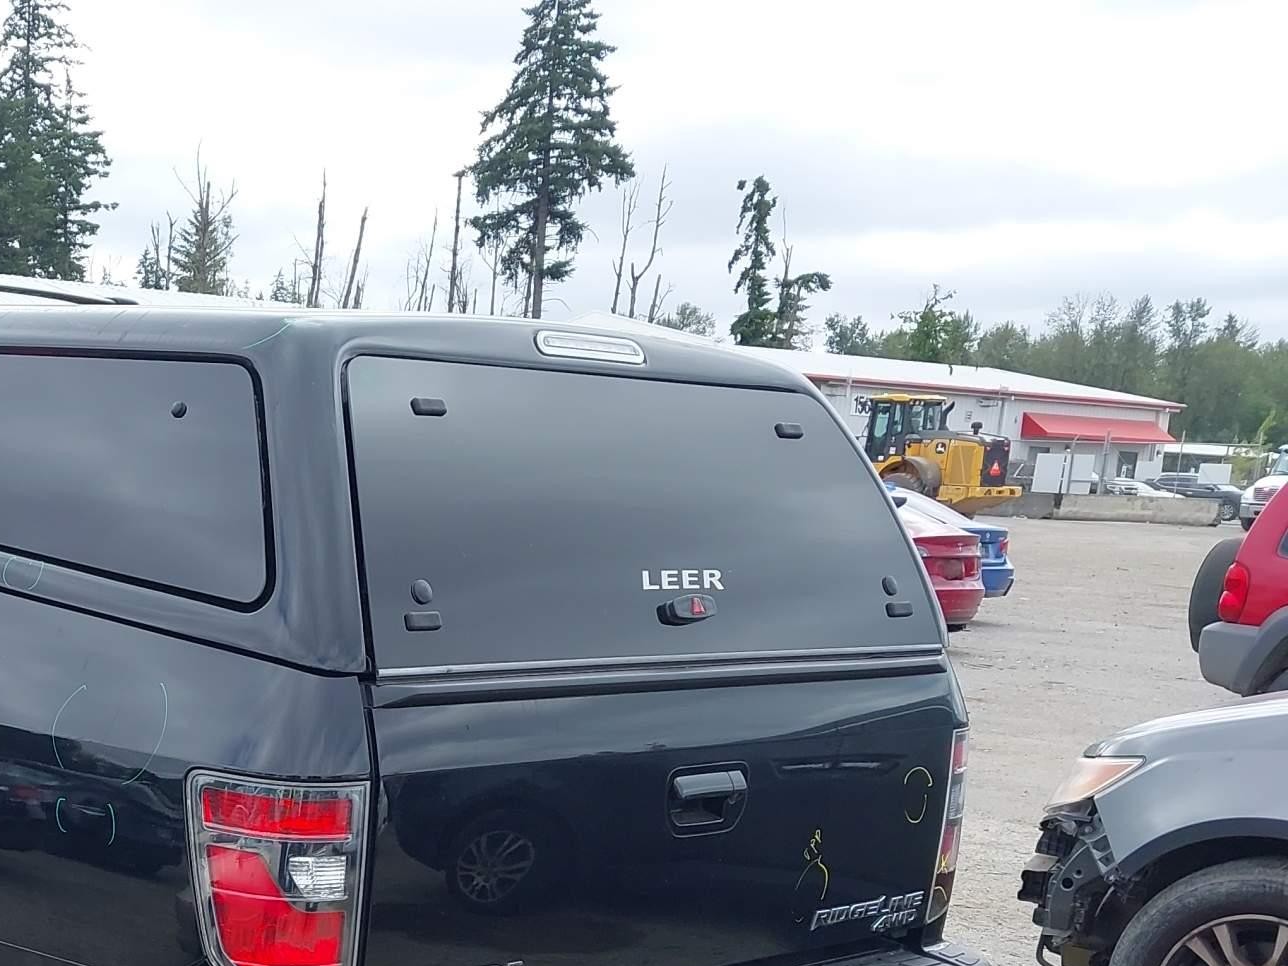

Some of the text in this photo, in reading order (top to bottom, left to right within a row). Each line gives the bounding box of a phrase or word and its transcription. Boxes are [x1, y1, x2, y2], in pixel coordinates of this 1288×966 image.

[642, 569, 725, 590] LEER
[811, 891, 925, 931] RIDGELINE
[872, 909, 917, 932] 4WD
